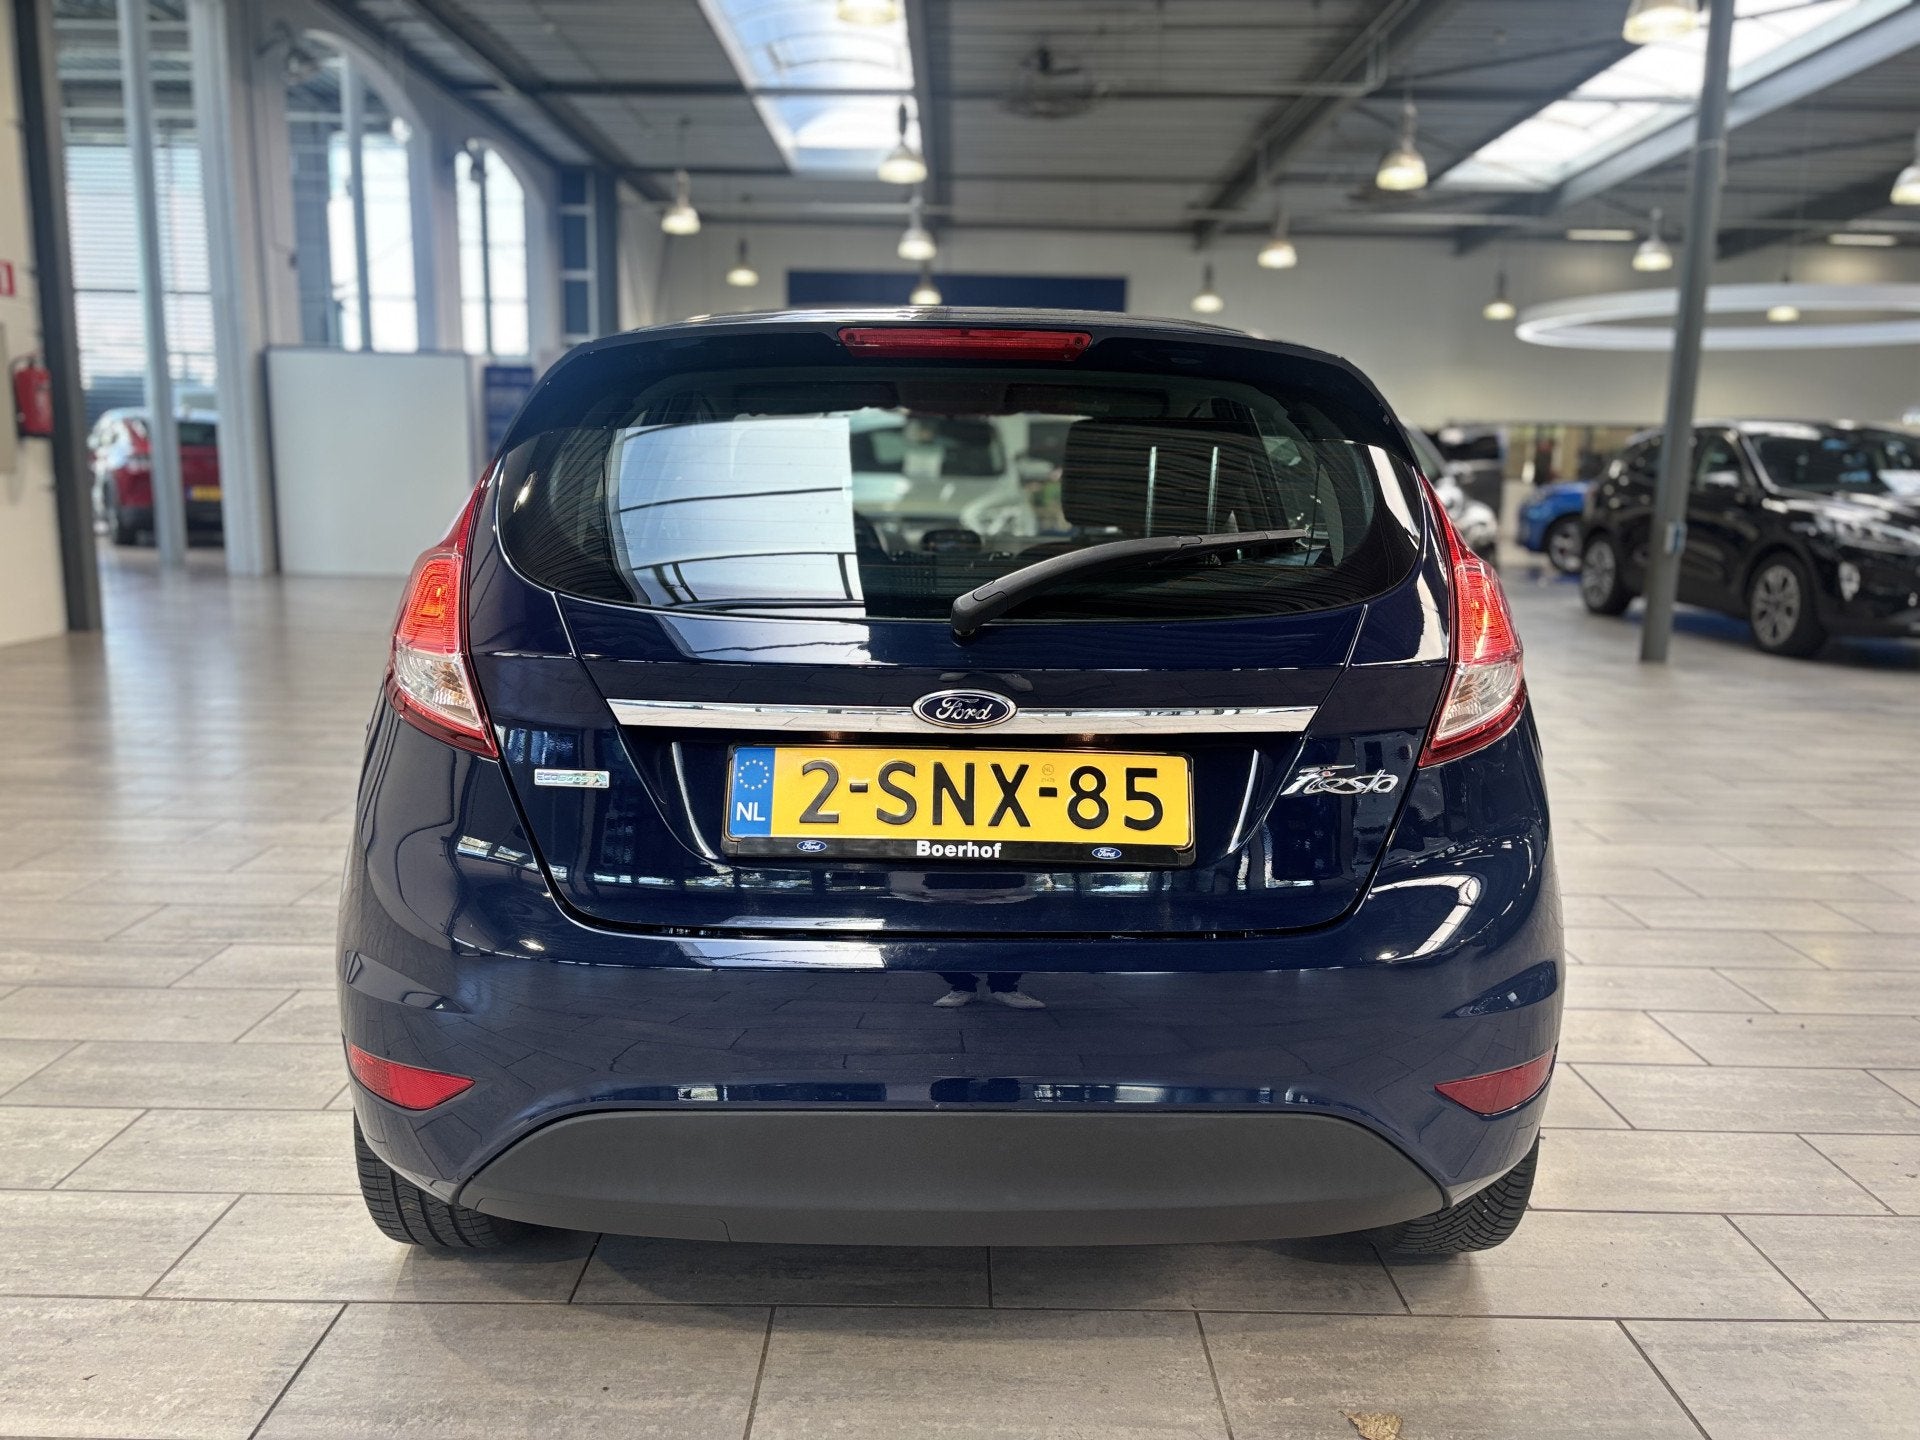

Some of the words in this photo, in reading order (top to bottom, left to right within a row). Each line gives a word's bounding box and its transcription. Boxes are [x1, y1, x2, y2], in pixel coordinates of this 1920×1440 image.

[936, 697, 993, 720] Ford
[1281, 764, 1399, 795] Fiesta
[799, 759, 1163, 831] 2-SNX-85
[736, 801, 766, 821] NL
[916, 840, 1002, 858] Boerhof
